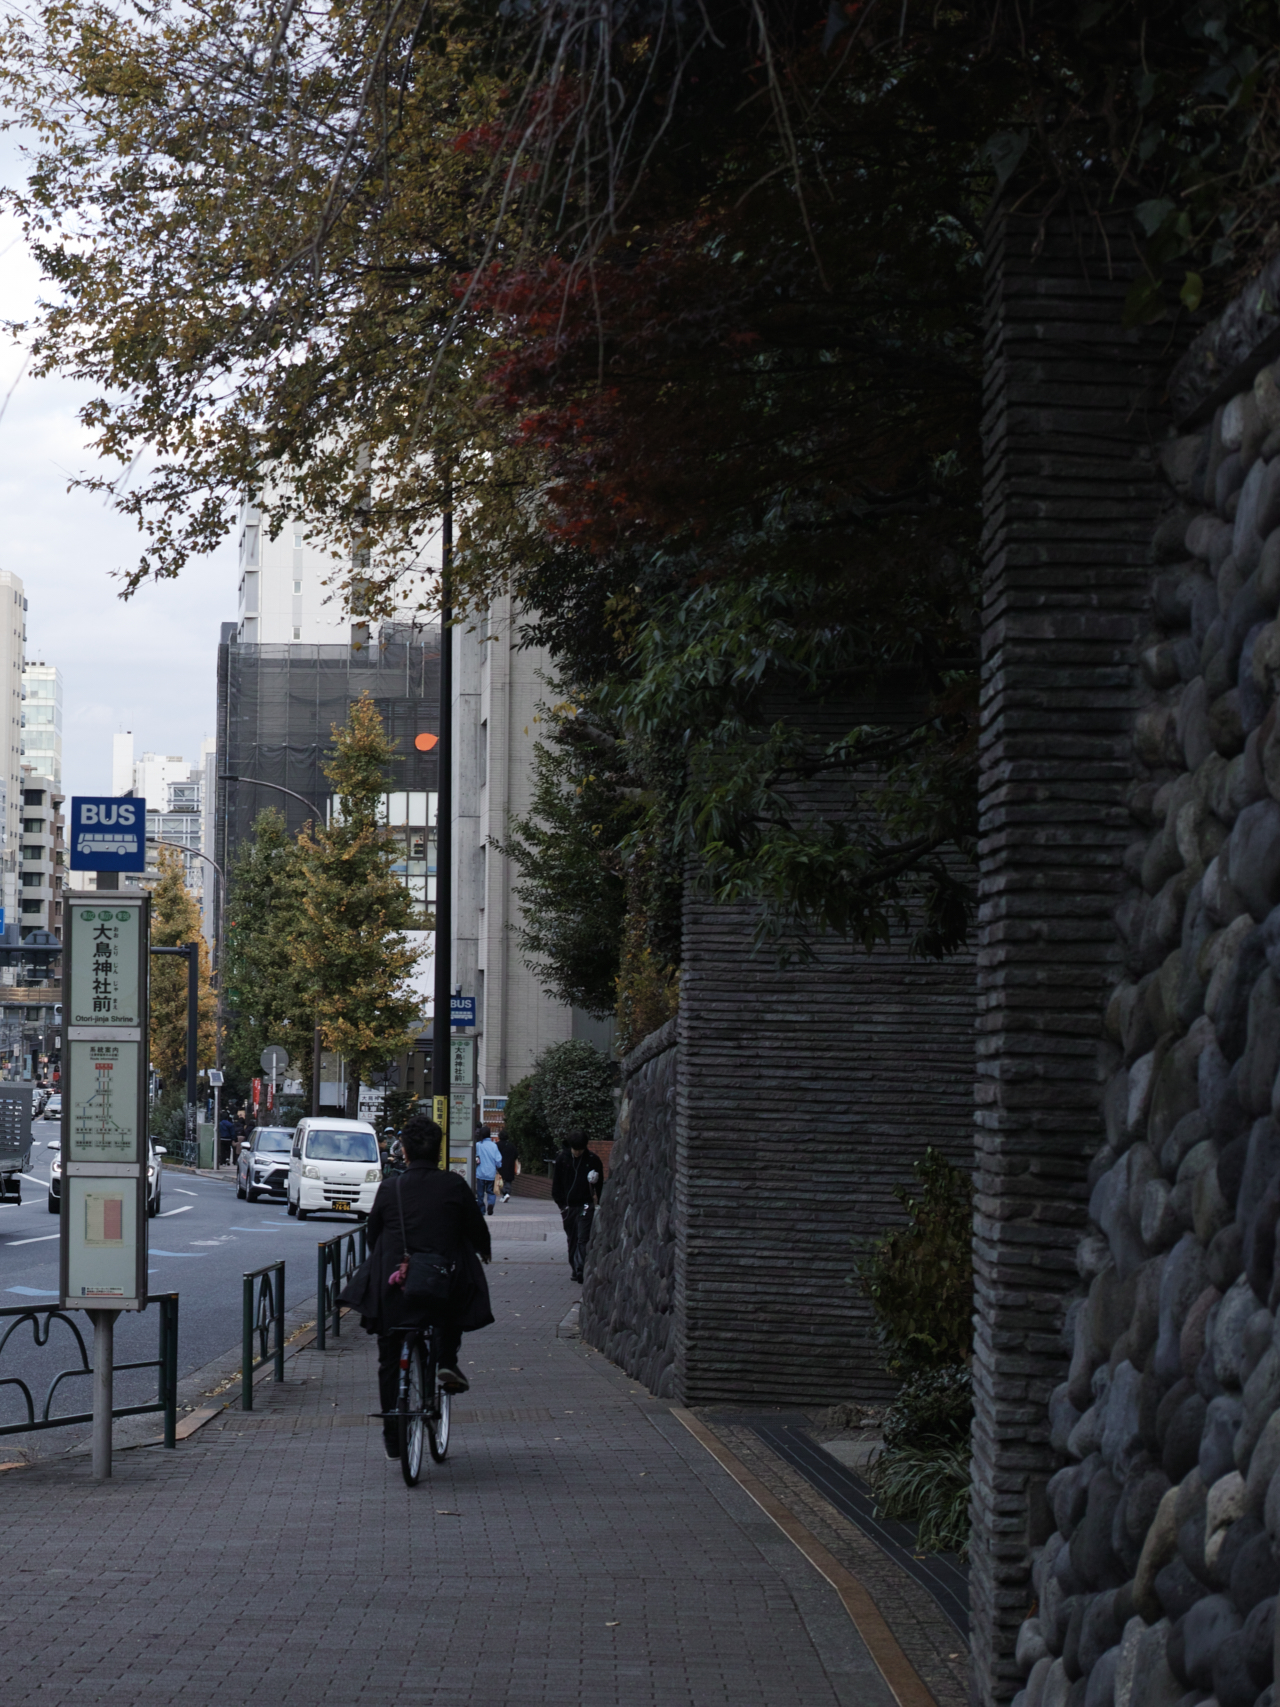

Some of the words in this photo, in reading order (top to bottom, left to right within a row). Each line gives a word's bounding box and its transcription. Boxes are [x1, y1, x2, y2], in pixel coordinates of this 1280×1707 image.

[80, 803, 136, 826] BUS
[92, 923, 113, 1013] 大鳥神社前
[450, 999, 472, 1008] BUS
[75, 1015, 109, 1023] Otori-jinja
[111, 1015, 134, 1023] Shrine
[454, 1046, 463, 1082] 大鳥神社前
